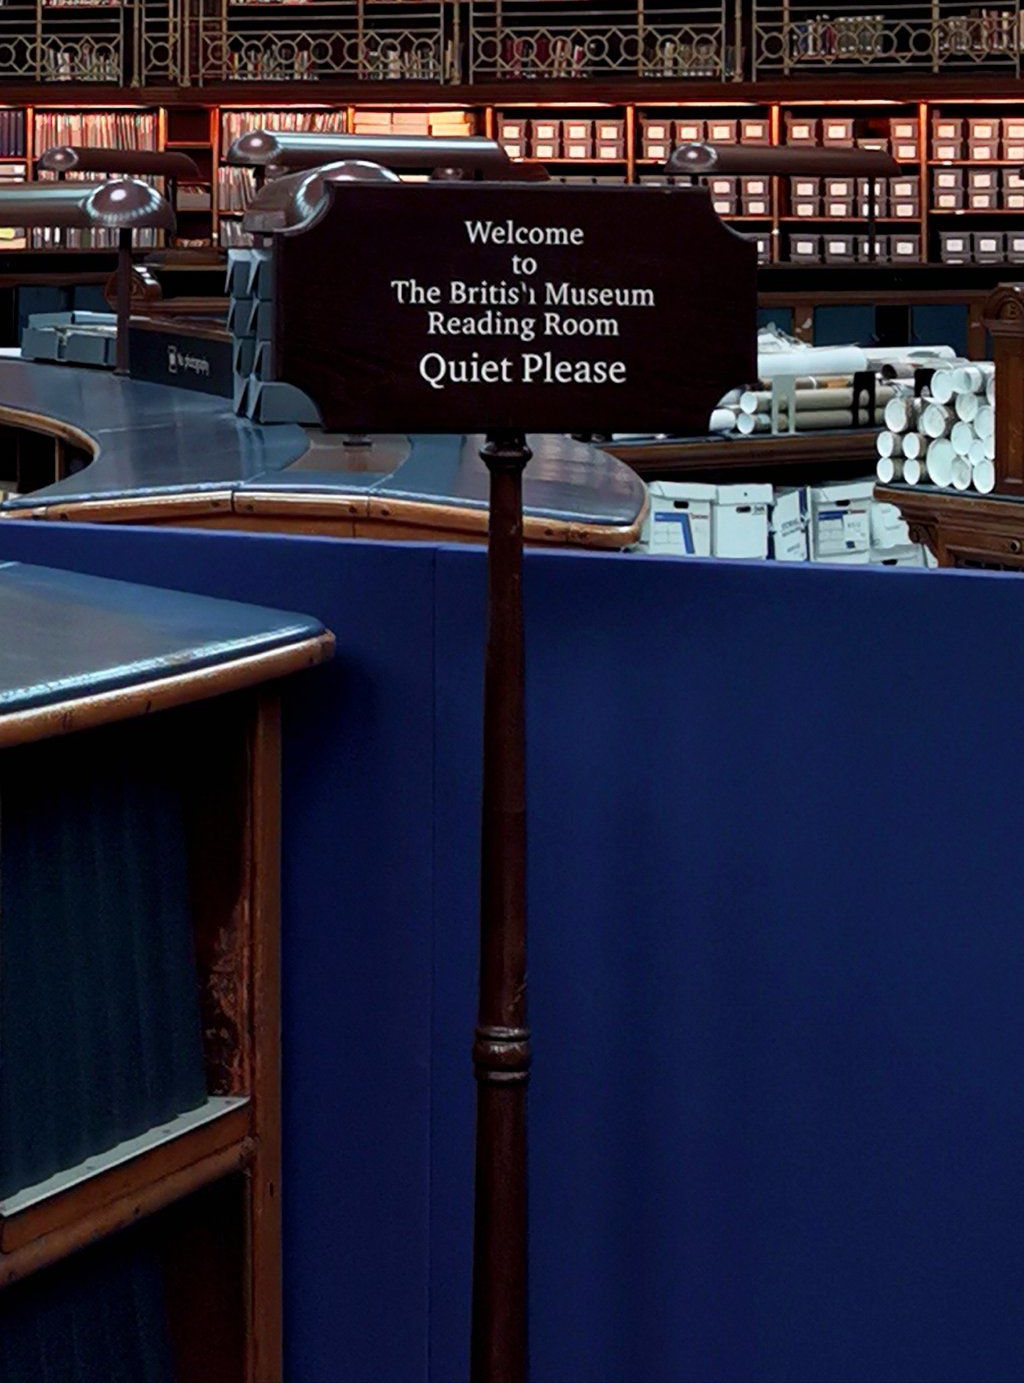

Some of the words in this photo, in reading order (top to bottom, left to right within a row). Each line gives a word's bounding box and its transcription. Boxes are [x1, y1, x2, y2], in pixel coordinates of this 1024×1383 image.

[465, 220, 584, 245] Welcome
[511, 254, 538, 275] to
[390, 279, 441, 304] The
[544, 282, 656, 306] Museum
[427, 310, 536, 342] Reading
[544, 313, 620, 336] Room
[419, 352, 513, 389] Quiet
[521, 351, 627, 384] Please
